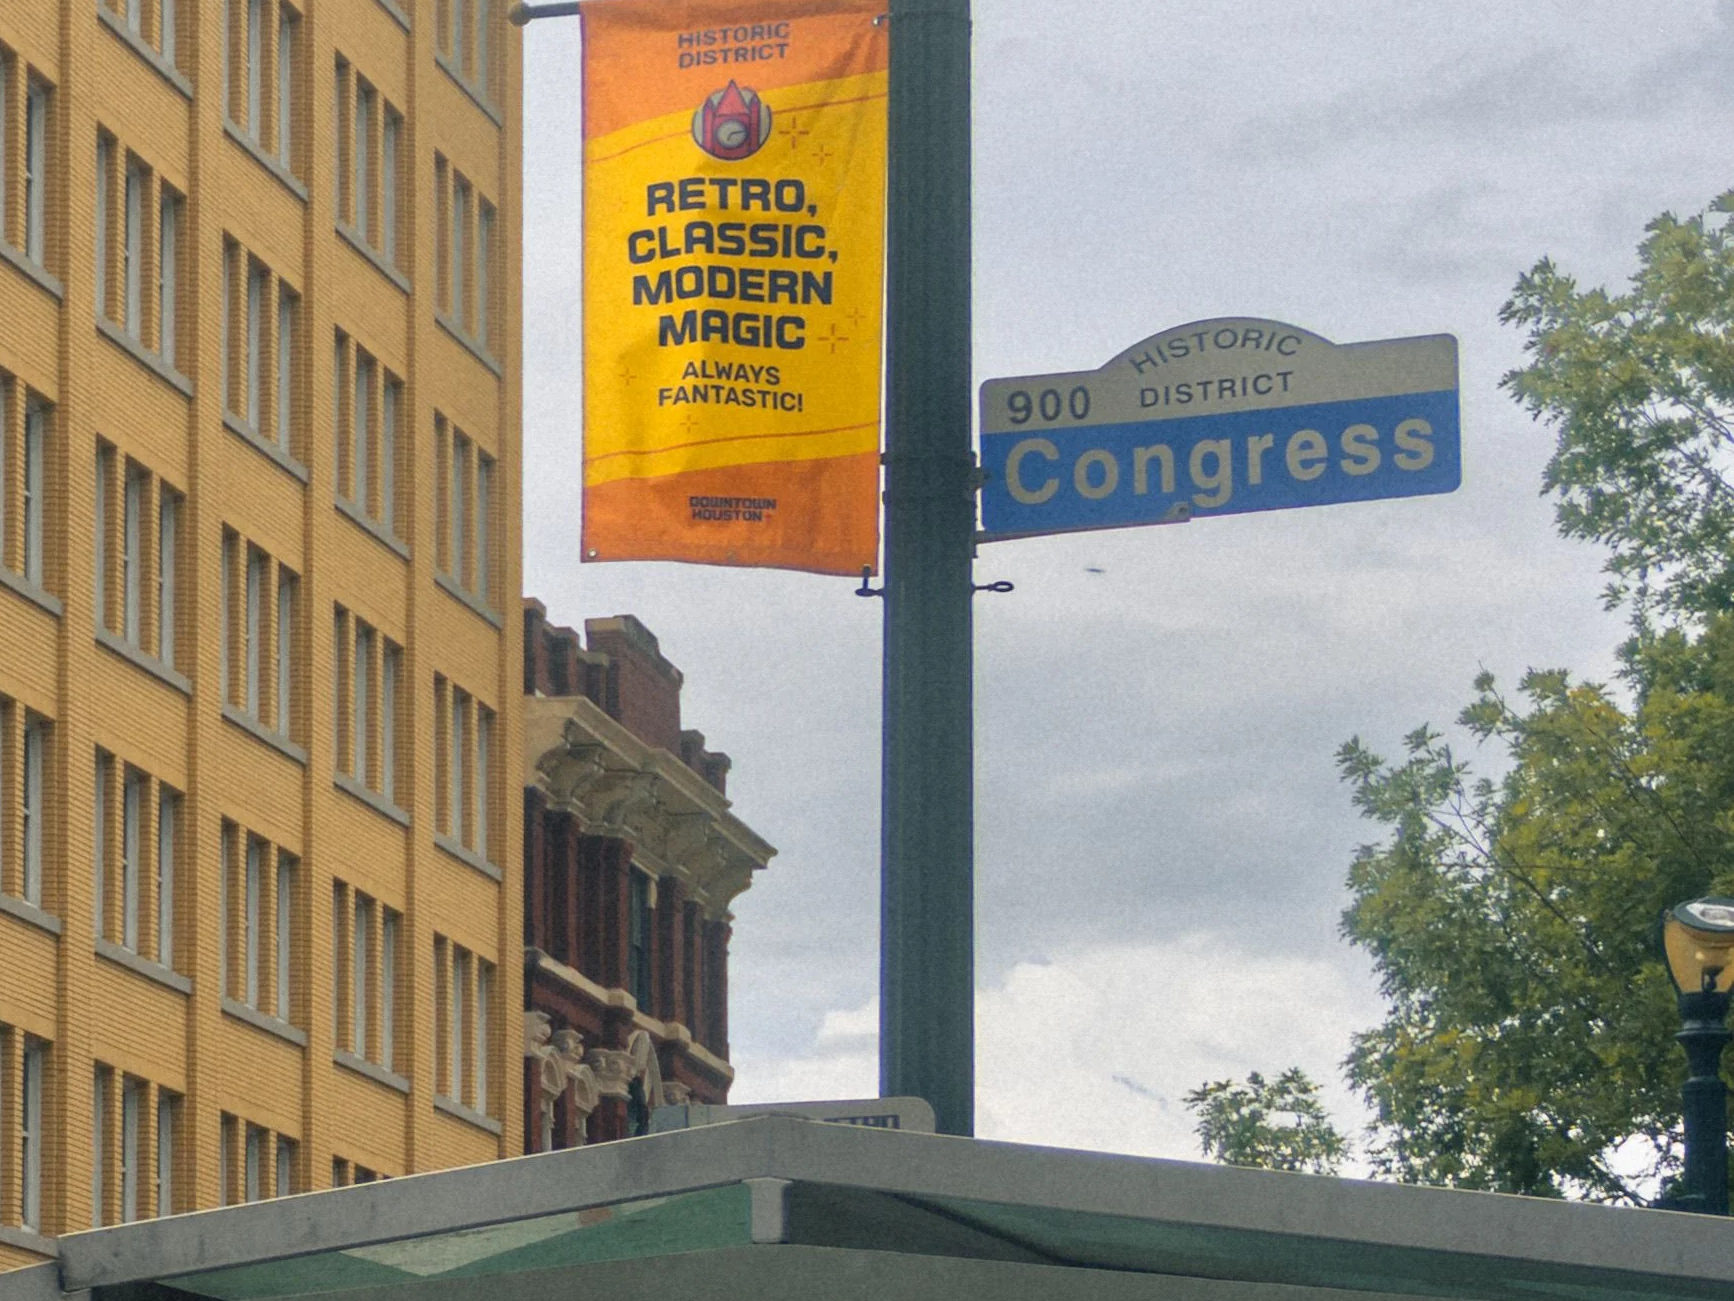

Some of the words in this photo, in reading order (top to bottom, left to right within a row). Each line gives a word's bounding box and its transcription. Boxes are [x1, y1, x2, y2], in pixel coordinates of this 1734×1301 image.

[677, 21, 792, 49] HISTORIC
[677, 42, 788, 69] DISTRICT
[646, 178, 817, 217] RETRO,
[627, 222, 839, 265] CLASSIC,
[632, 266, 833, 306] MODERN
[657, 309, 806, 350] MAGIC
[1129, 327, 1304, 376] HISTORIC
[681, 360, 781, 387] ALWAYS
[657, 384, 805, 413] FANTASTIC!
[1005, 385, 1092, 425] 900
[1139, 370, 1295, 409] DISTRICT
[1004, 417, 1436, 508] Congress
[688, 496, 778, 511] DOWNTOWN
